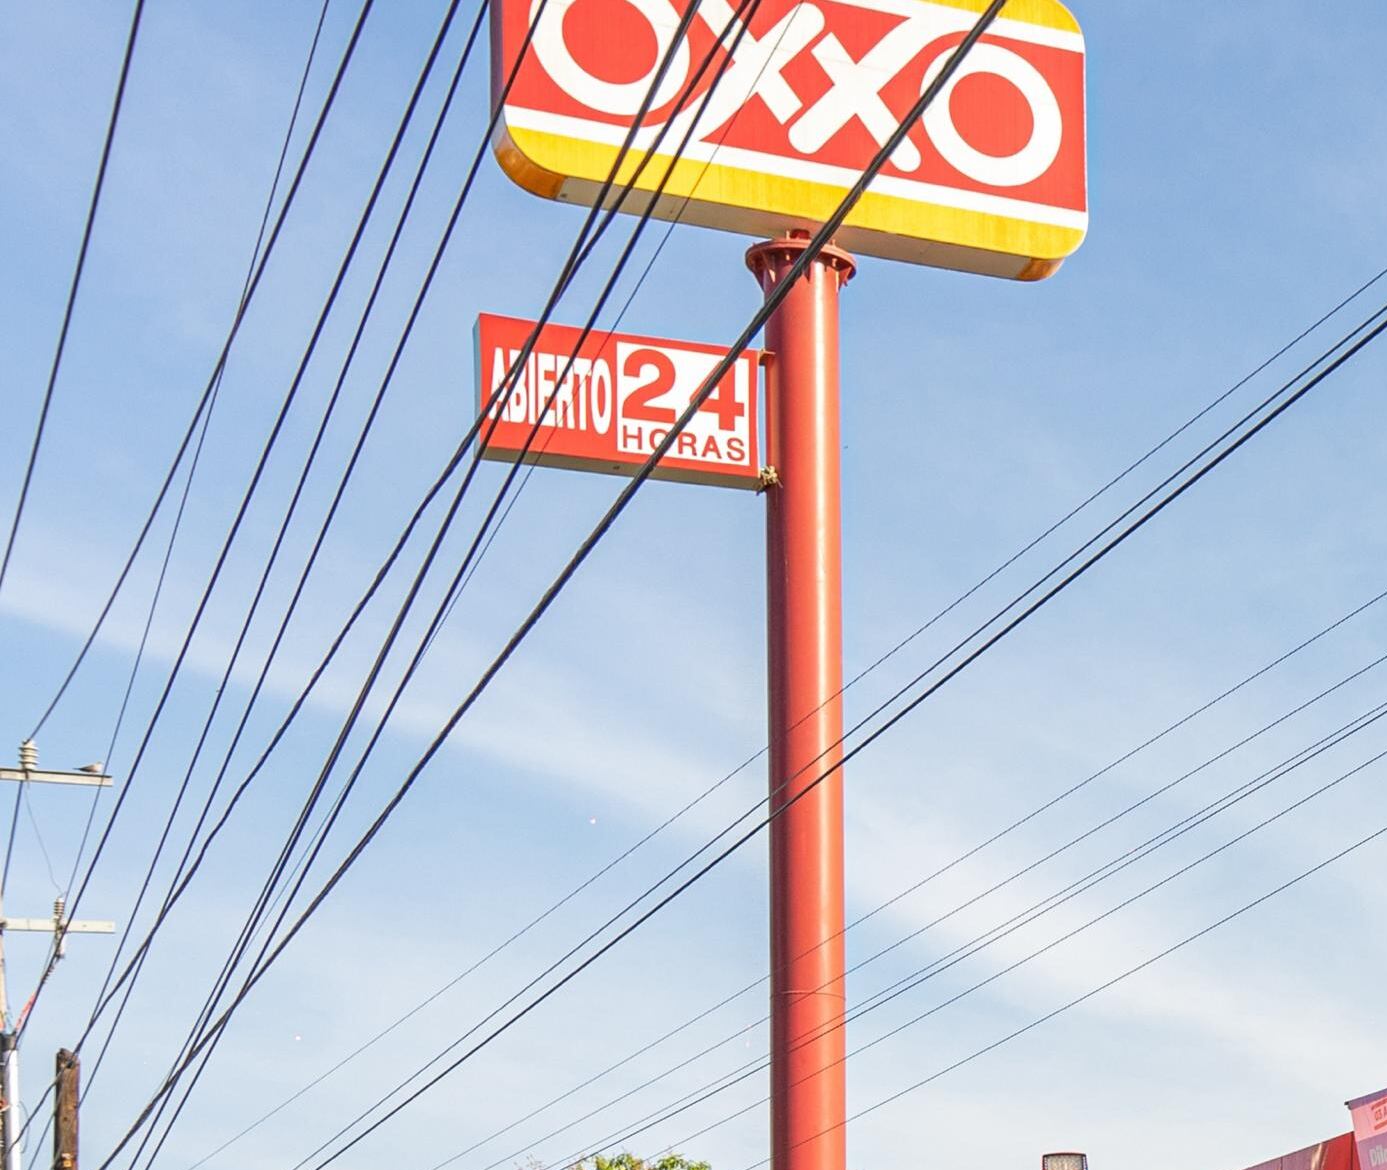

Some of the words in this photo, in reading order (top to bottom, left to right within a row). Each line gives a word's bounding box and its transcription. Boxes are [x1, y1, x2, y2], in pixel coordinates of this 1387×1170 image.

[528, 0, 1062, 186] OXXO
[488, 347, 612, 435] ABIERTO
[622, 348, 745, 431] 24
[622, 425, 746, 461] HORAS
